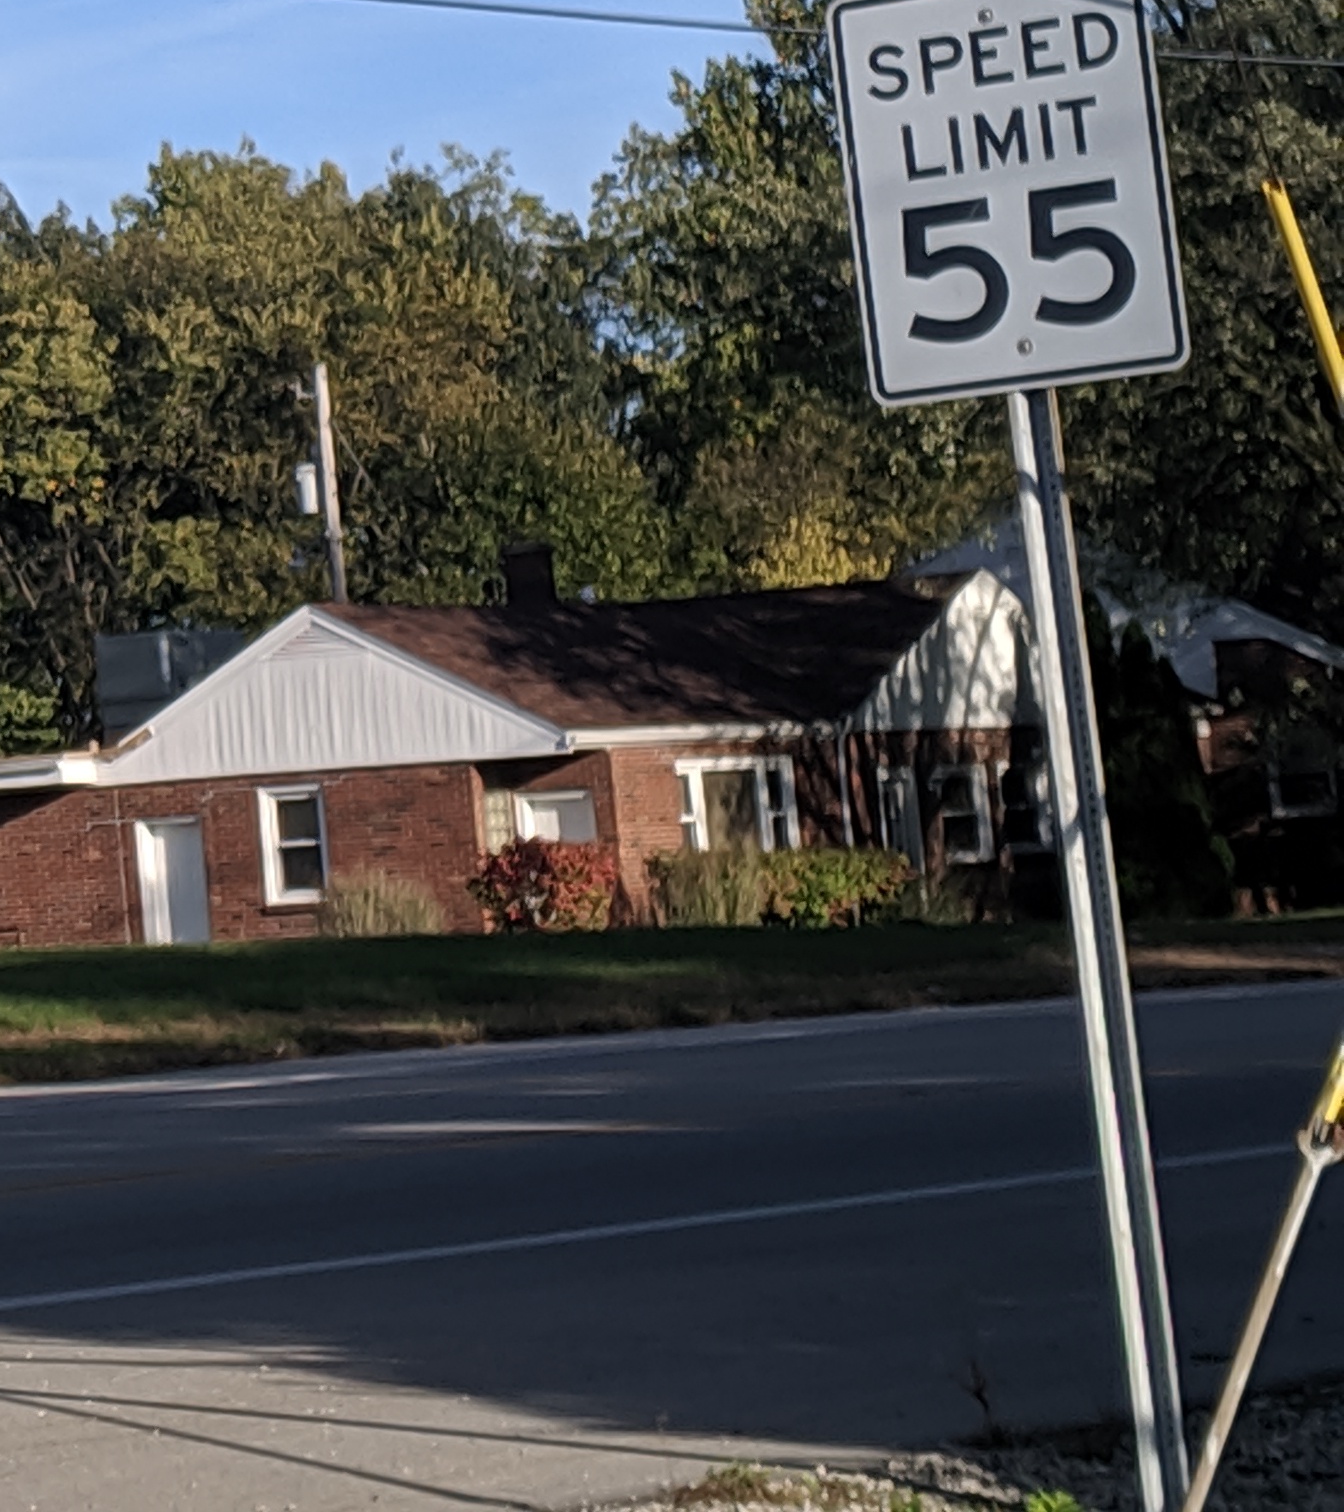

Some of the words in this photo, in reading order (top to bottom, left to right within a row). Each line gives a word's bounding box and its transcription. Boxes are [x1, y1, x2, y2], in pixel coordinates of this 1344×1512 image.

[868, 12, 1118, 100] SPEED
[901, 95, 1096, 180] LIMIT
[901, 178, 1137, 343] 55
